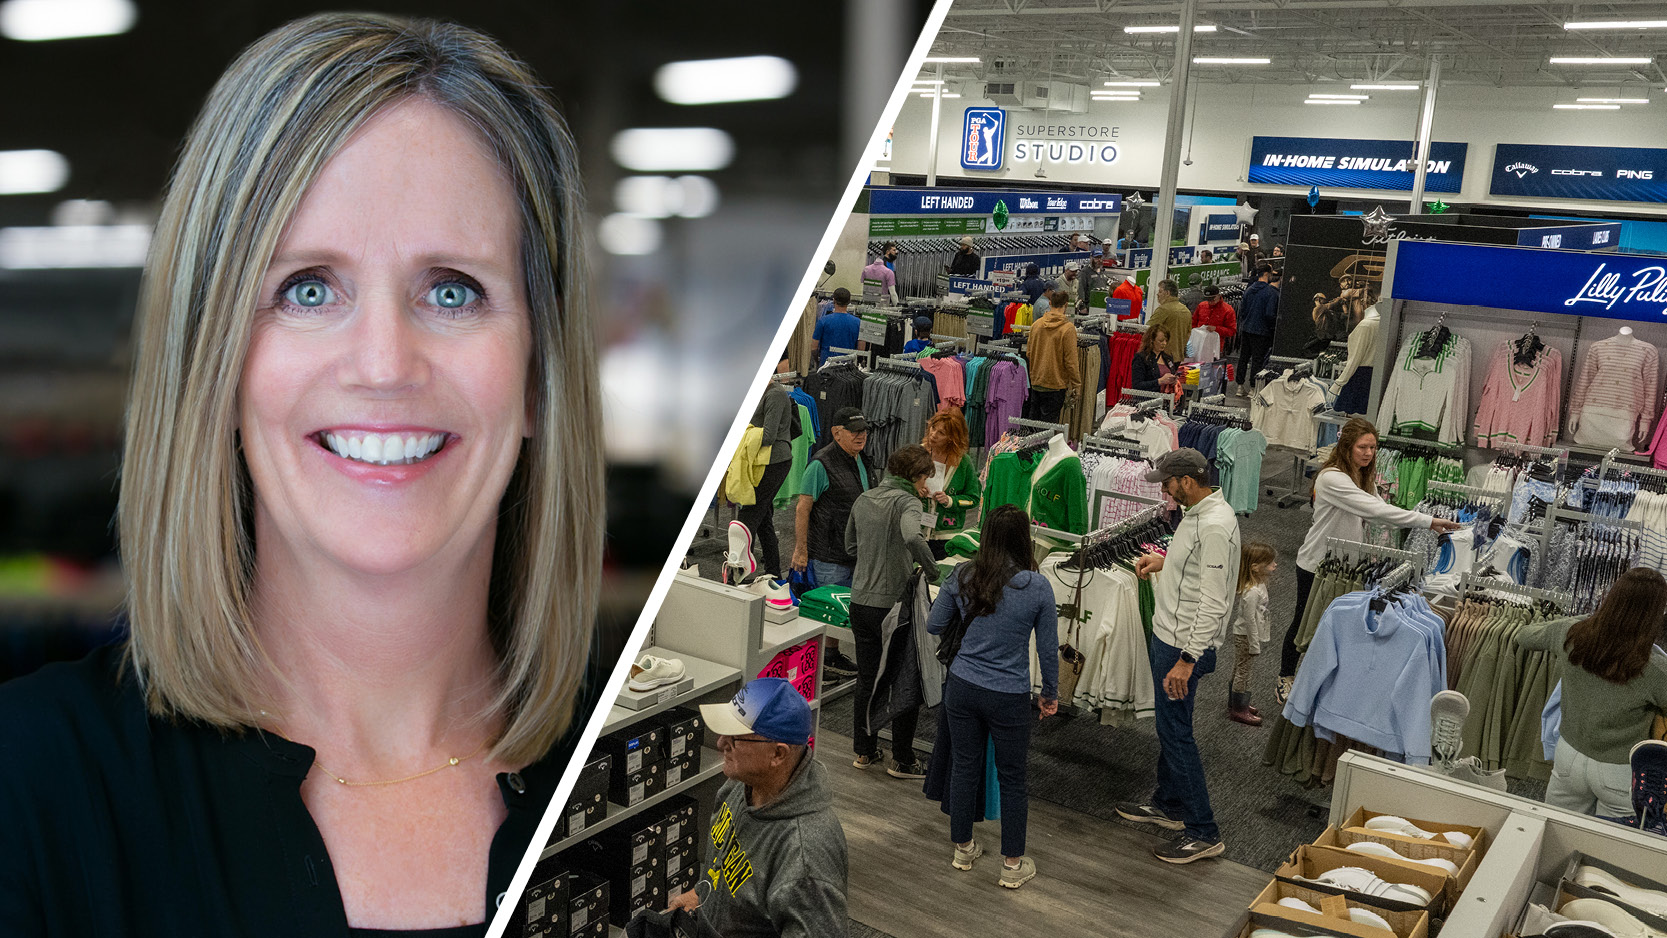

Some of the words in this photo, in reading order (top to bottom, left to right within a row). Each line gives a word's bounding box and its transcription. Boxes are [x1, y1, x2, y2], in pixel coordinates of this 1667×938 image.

[1017, 125, 1120, 138] SUPERSTORE
[968, 124, 980, 161] TOUR
[1015, 143, 1118, 163] STUDIO
[1262, 154, 1336, 169] IN-HOME
[1337, 156, 1451, 174] SIMULAON
[1505, 161, 1539, 174] Callaway
[1551, 168, 1603, 177] cobra
[1616, 169, 1654, 180] PING
[921, 196, 940, 209] LEFT
[941, 196, 974, 209] HANDED
[1019, 198, 1039, 209] Wilson
[1080, 198, 1115, 210] cobra
[953, 281, 972, 290] LEFT
[972, 284, 1006, 293] HANDED
[1564, 263, 1627, 310] Lilly
[1623, 266, 1667, 315] Puli
